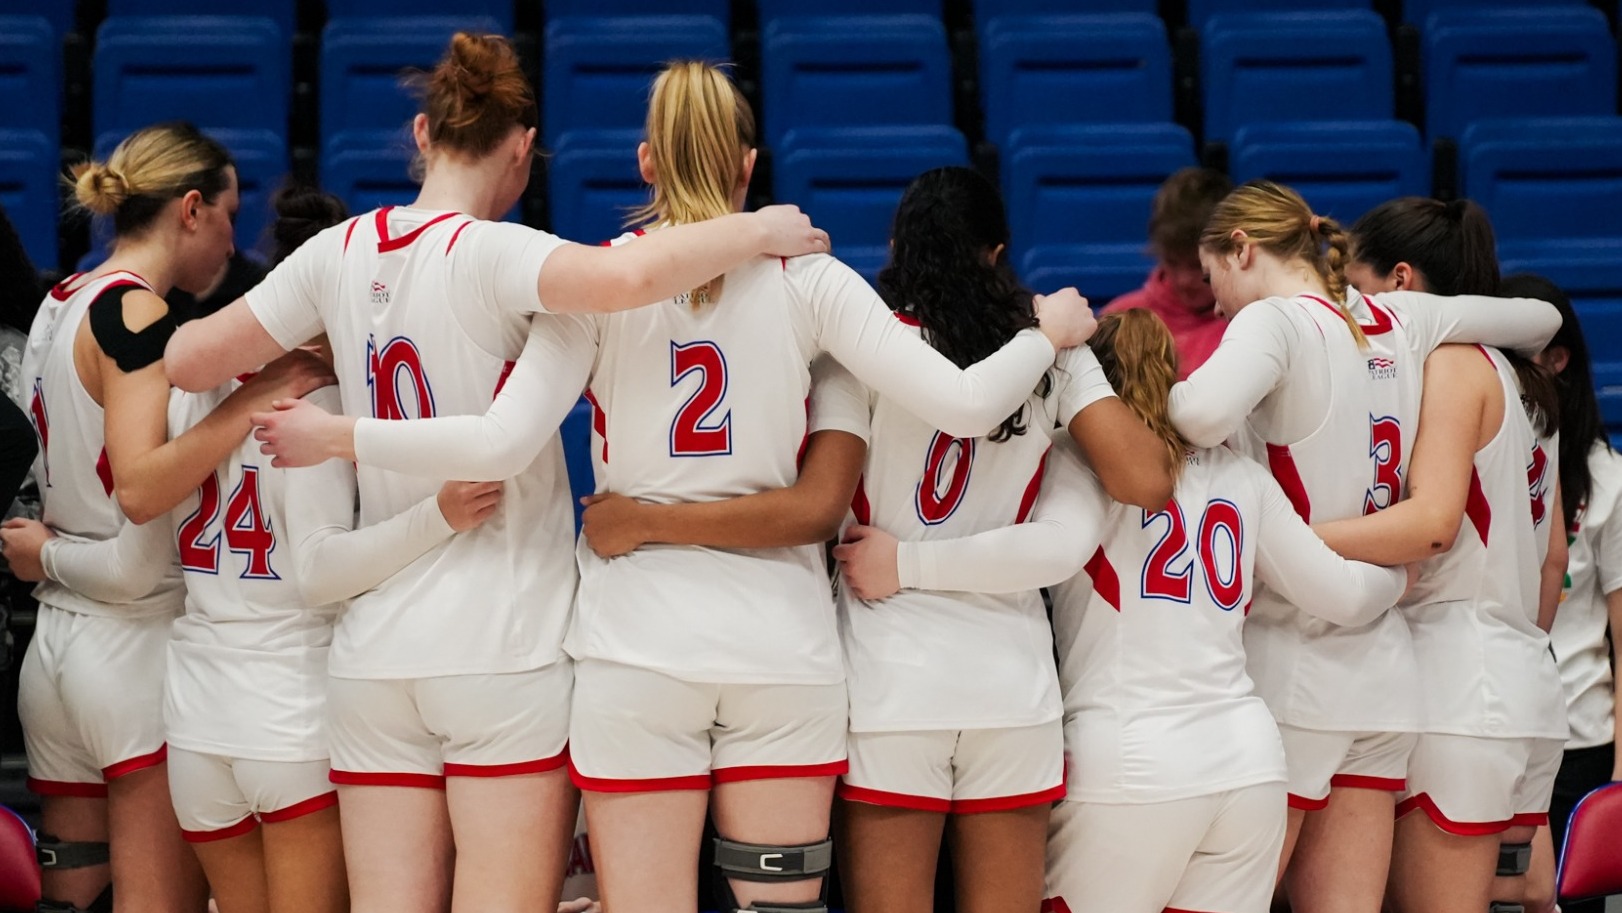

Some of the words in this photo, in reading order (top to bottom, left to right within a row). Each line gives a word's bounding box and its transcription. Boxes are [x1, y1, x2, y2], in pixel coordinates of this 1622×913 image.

[367, 332, 436, 420] 10
[670, 339, 732, 457] 2
[915, 428, 976, 526] 0
[1362, 411, 1402, 517] 3
[177, 464, 282, 580] 24
[1141, 497, 1244, 612] 20
